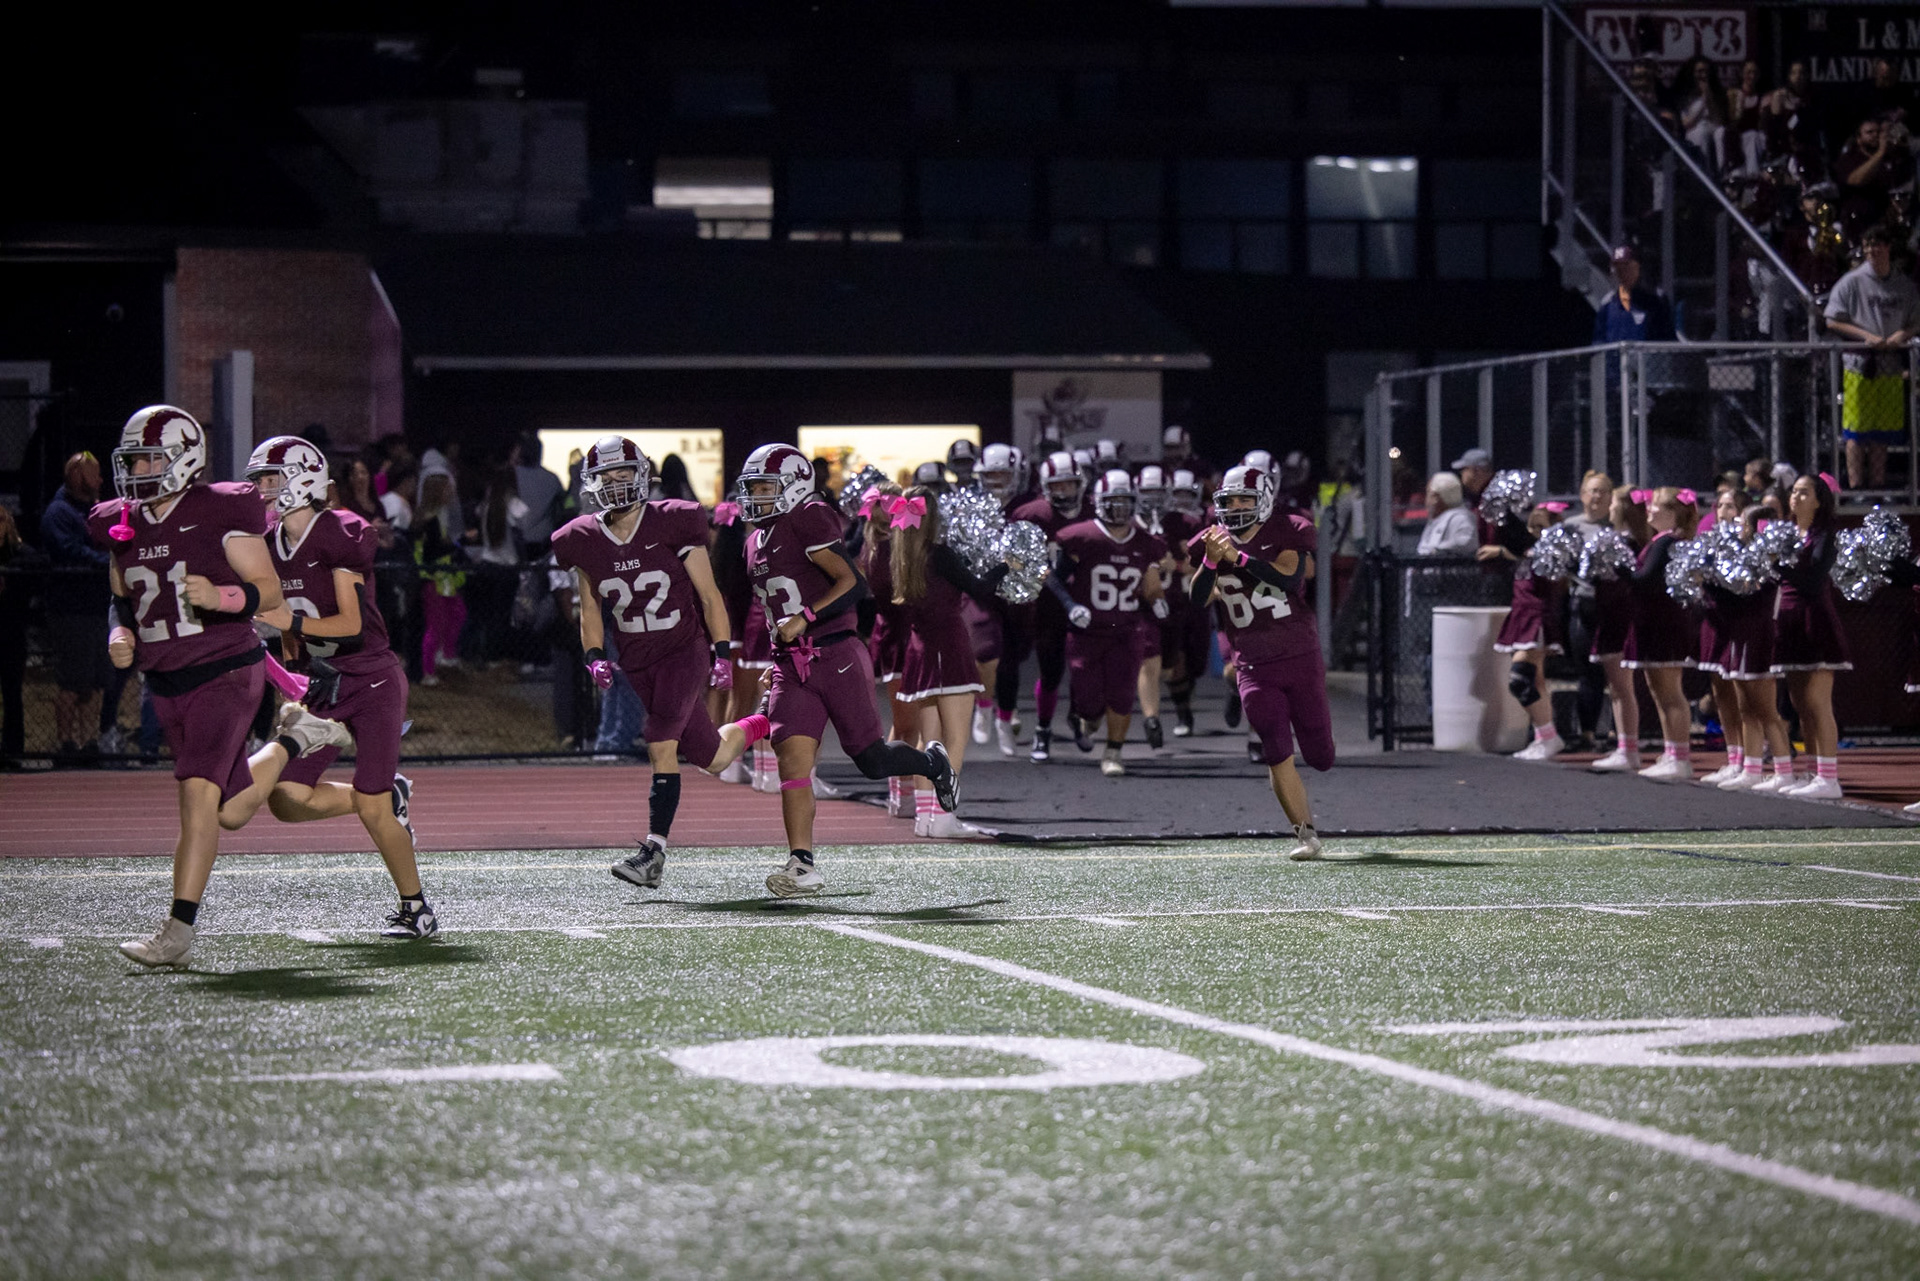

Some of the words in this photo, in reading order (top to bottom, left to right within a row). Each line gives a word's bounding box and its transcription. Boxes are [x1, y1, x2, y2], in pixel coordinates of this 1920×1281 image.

[1857, 17, 1876, 50] L
[1881, 20, 1901, 50] &
[1809, 55, 1920, 83] LANDA
[137, 545, 170, 560] RAMS
[614, 558, 641, 572] RAMS
[124, 561, 204, 643] 21
[598, 570, 682, 633] 22
[1090, 564, 1142, 612] 62
[1217, 573, 1292, 629] 64
